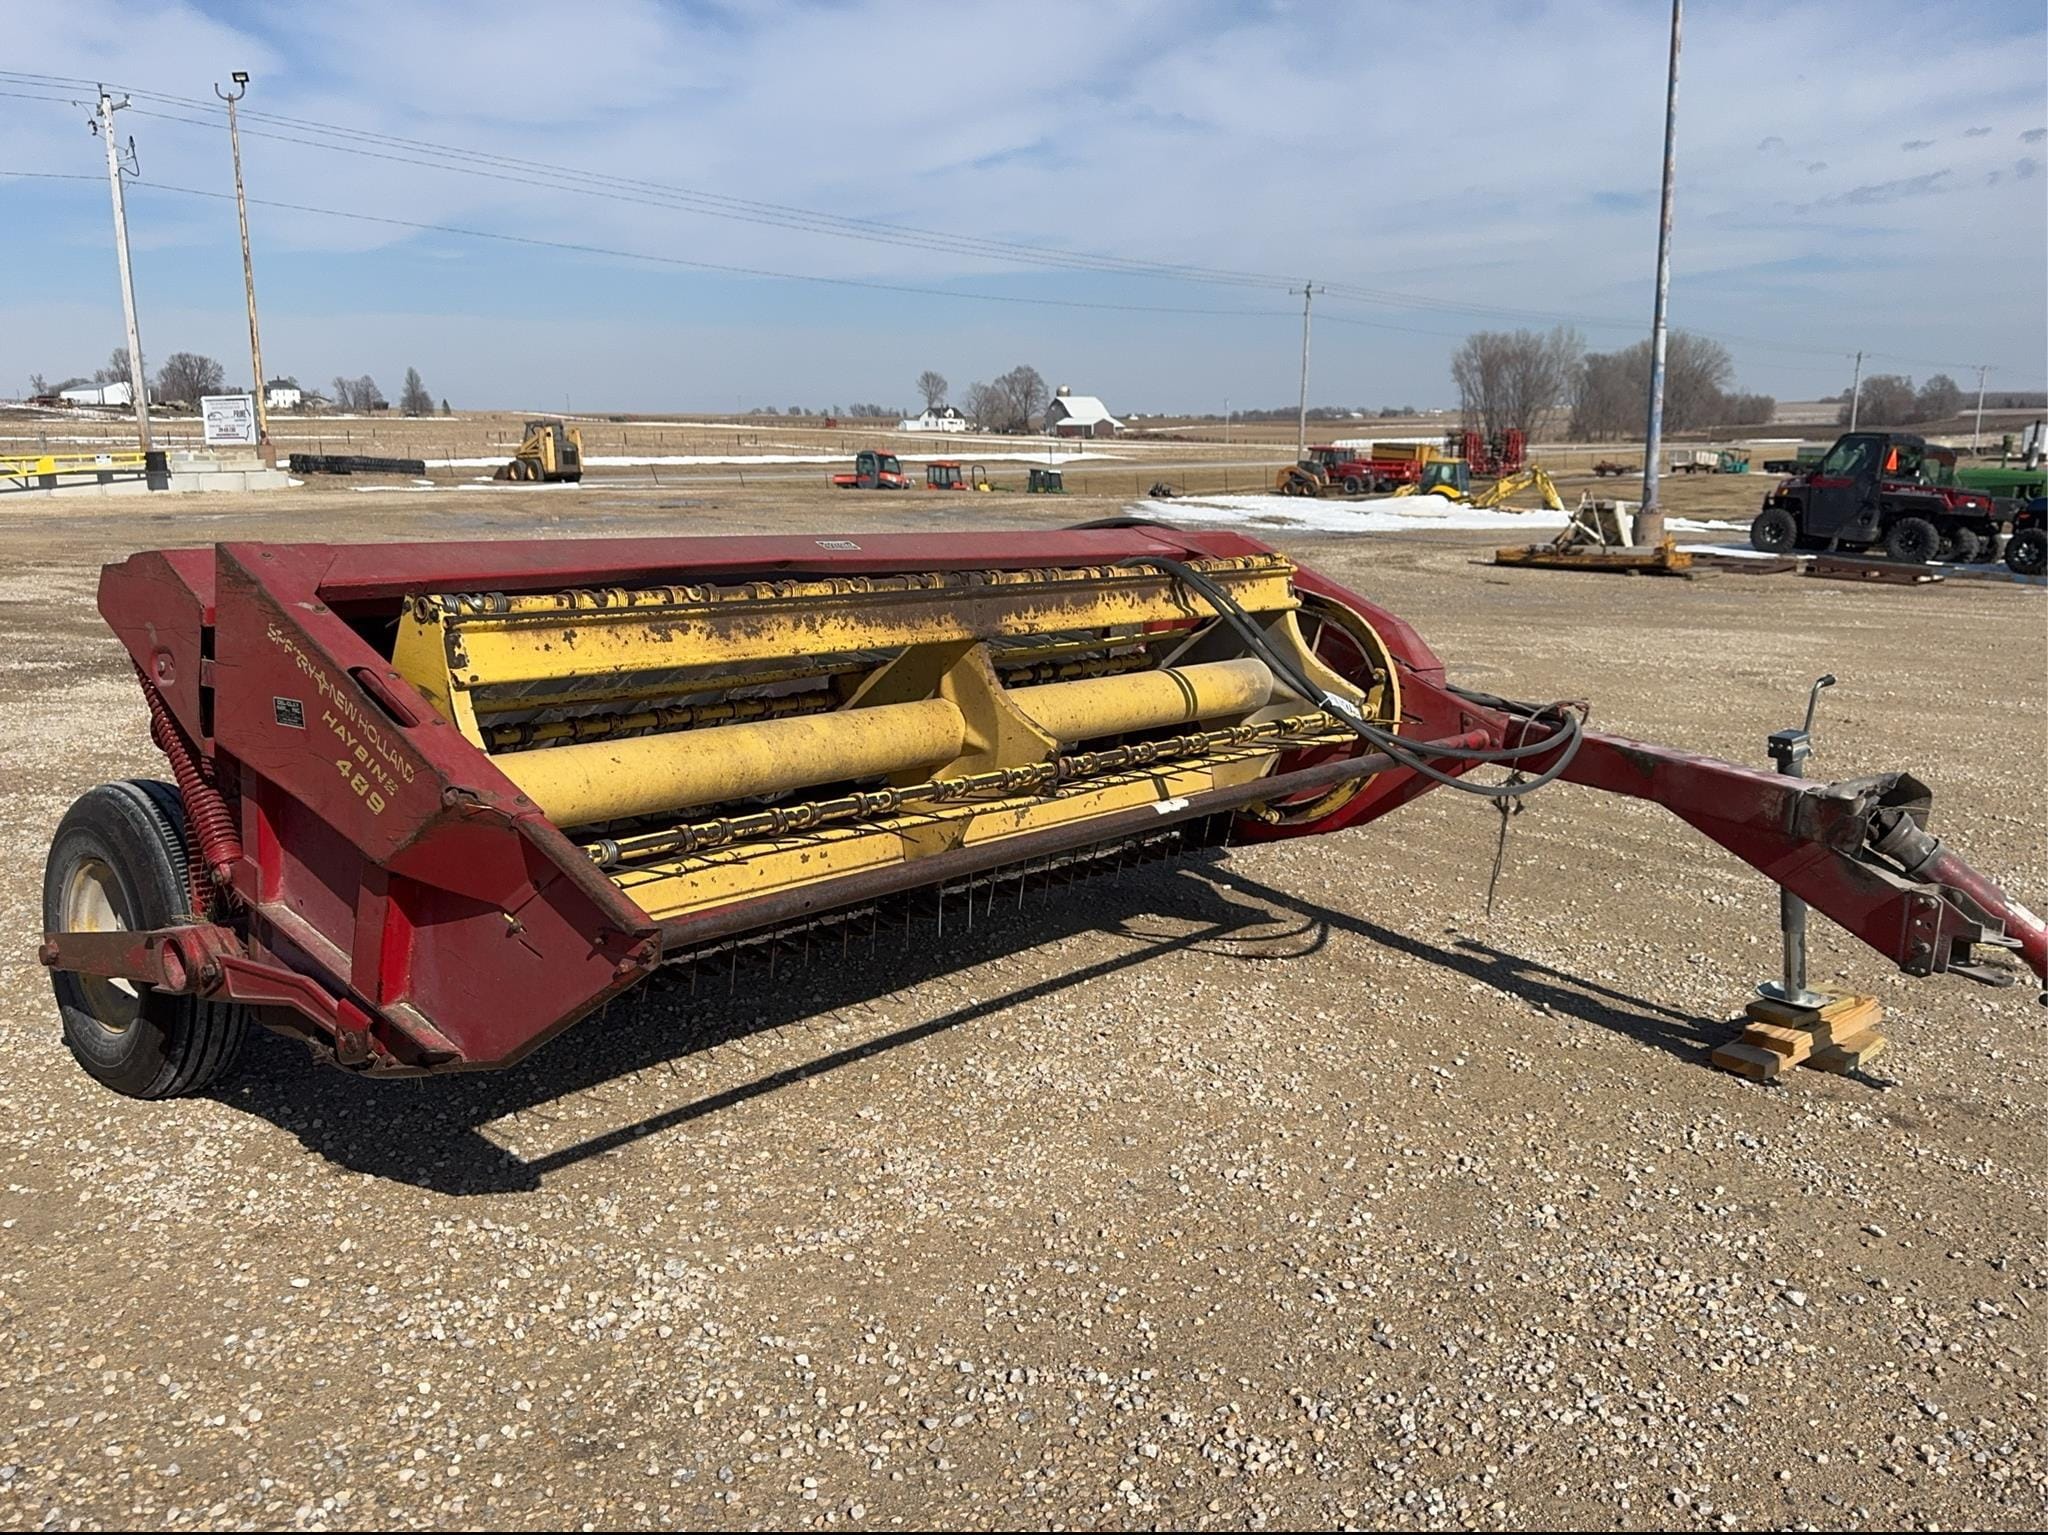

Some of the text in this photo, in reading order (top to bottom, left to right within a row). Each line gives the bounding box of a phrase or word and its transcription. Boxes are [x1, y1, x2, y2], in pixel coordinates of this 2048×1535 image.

[322, 710, 398, 797] HAYBINE
[328, 683, 357, 722] NEW
[357, 713, 415, 784] HOLLAND
[335, 760, 386, 816] 489
